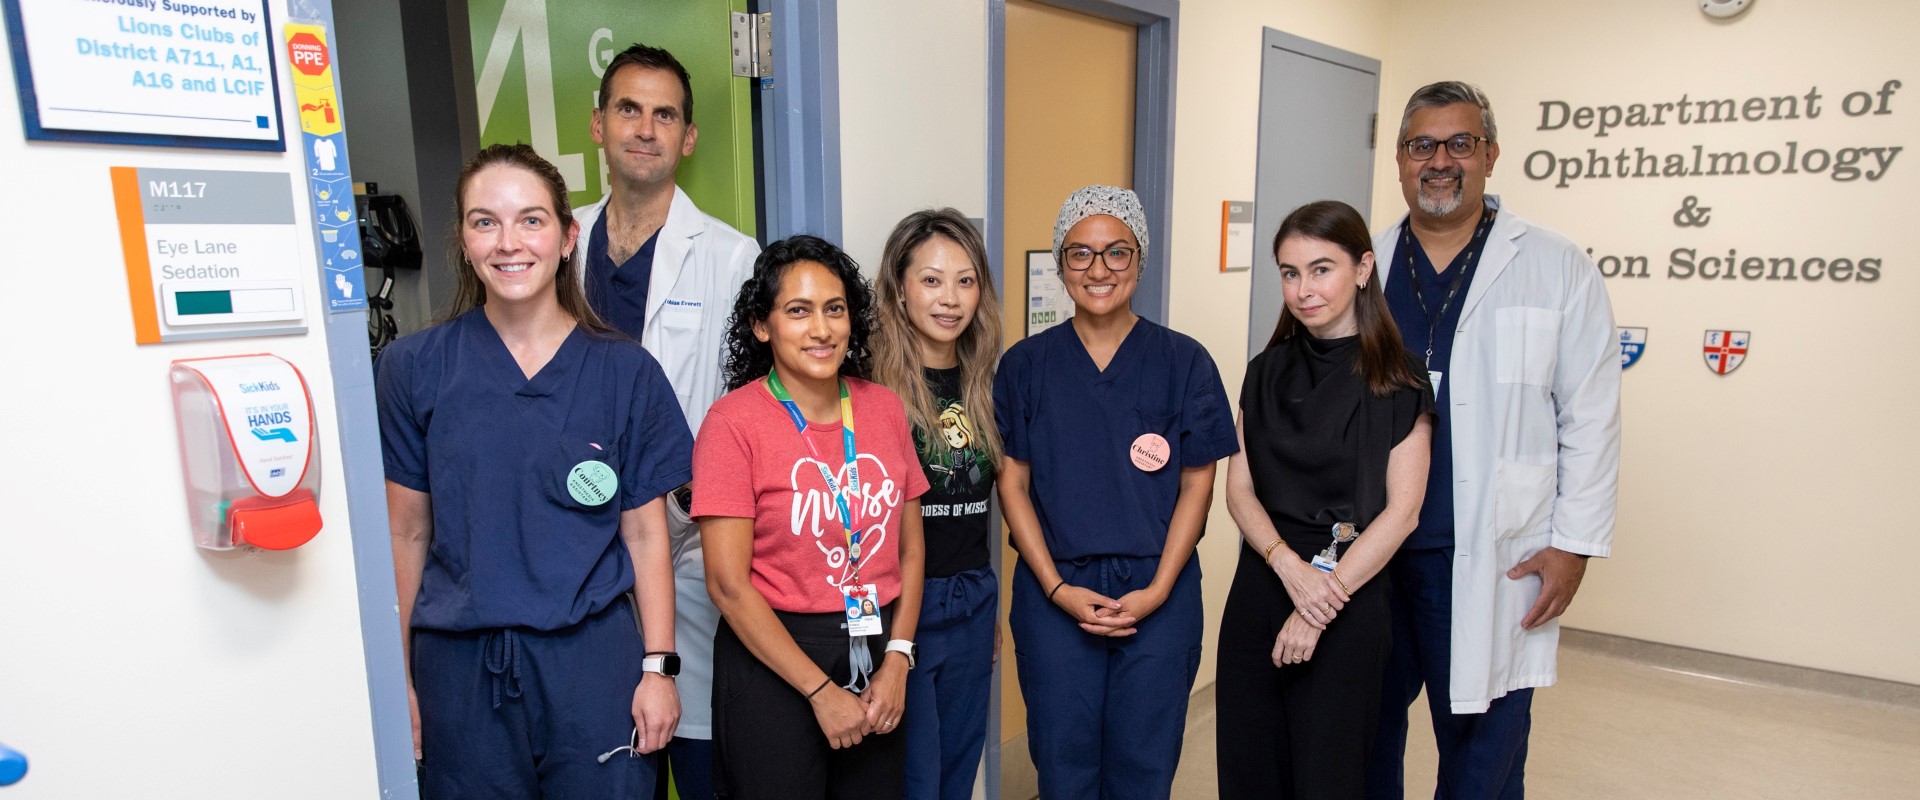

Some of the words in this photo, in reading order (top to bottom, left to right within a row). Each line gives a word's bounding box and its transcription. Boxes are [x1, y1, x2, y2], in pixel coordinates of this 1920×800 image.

[163, 0, 236, 20] Supported
[241, 9, 257, 23] by
[118, 16, 173, 37] Lions
[180, 23, 235, 44] Clubs
[242, 32, 260, 47] of
[76, 38, 158, 62] District
[165, 48, 226, 70] A711,
[232, 54, 263, 72] A1,
[292, 43, 321, 51] DONNING
[294, 51, 324, 66] PPE
[132, 70, 174, 90] A16
[182, 77, 217, 93] and
[223, 79, 266, 96] LCIF
[1536, 85, 1824, 138] Department
[1841, 79, 1902, 117] of
[312, 168, 319, 176] 2
[1523, 142, 1904, 189] Ophthalmology
[150, 181, 207, 199] M117
[320, 214, 326, 222] 3
[1672, 195, 1712, 228] &
[157, 240, 189, 259] Eye
[195, 239, 238, 254] Lane
[162, 264, 240, 280] Sedation
[326, 258, 333, 266] 4
[1667, 248, 1883, 283] Sciences
[239, 381, 280, 394] SickKids
[245, 406, 259, 414] IT'S
[269, 403, 289, 412] YOUR
[248, 411, 292, 427] HANDS
[1132, 445, 1165, 465] Christine
[574, 467, 608, 502] Courtney
[820, 465, 837, 492] SickKids
[850, 466, 858, 492] SickKids
[791, 479, 900, 538] nuse
[953, 504, 964, 517] OF
